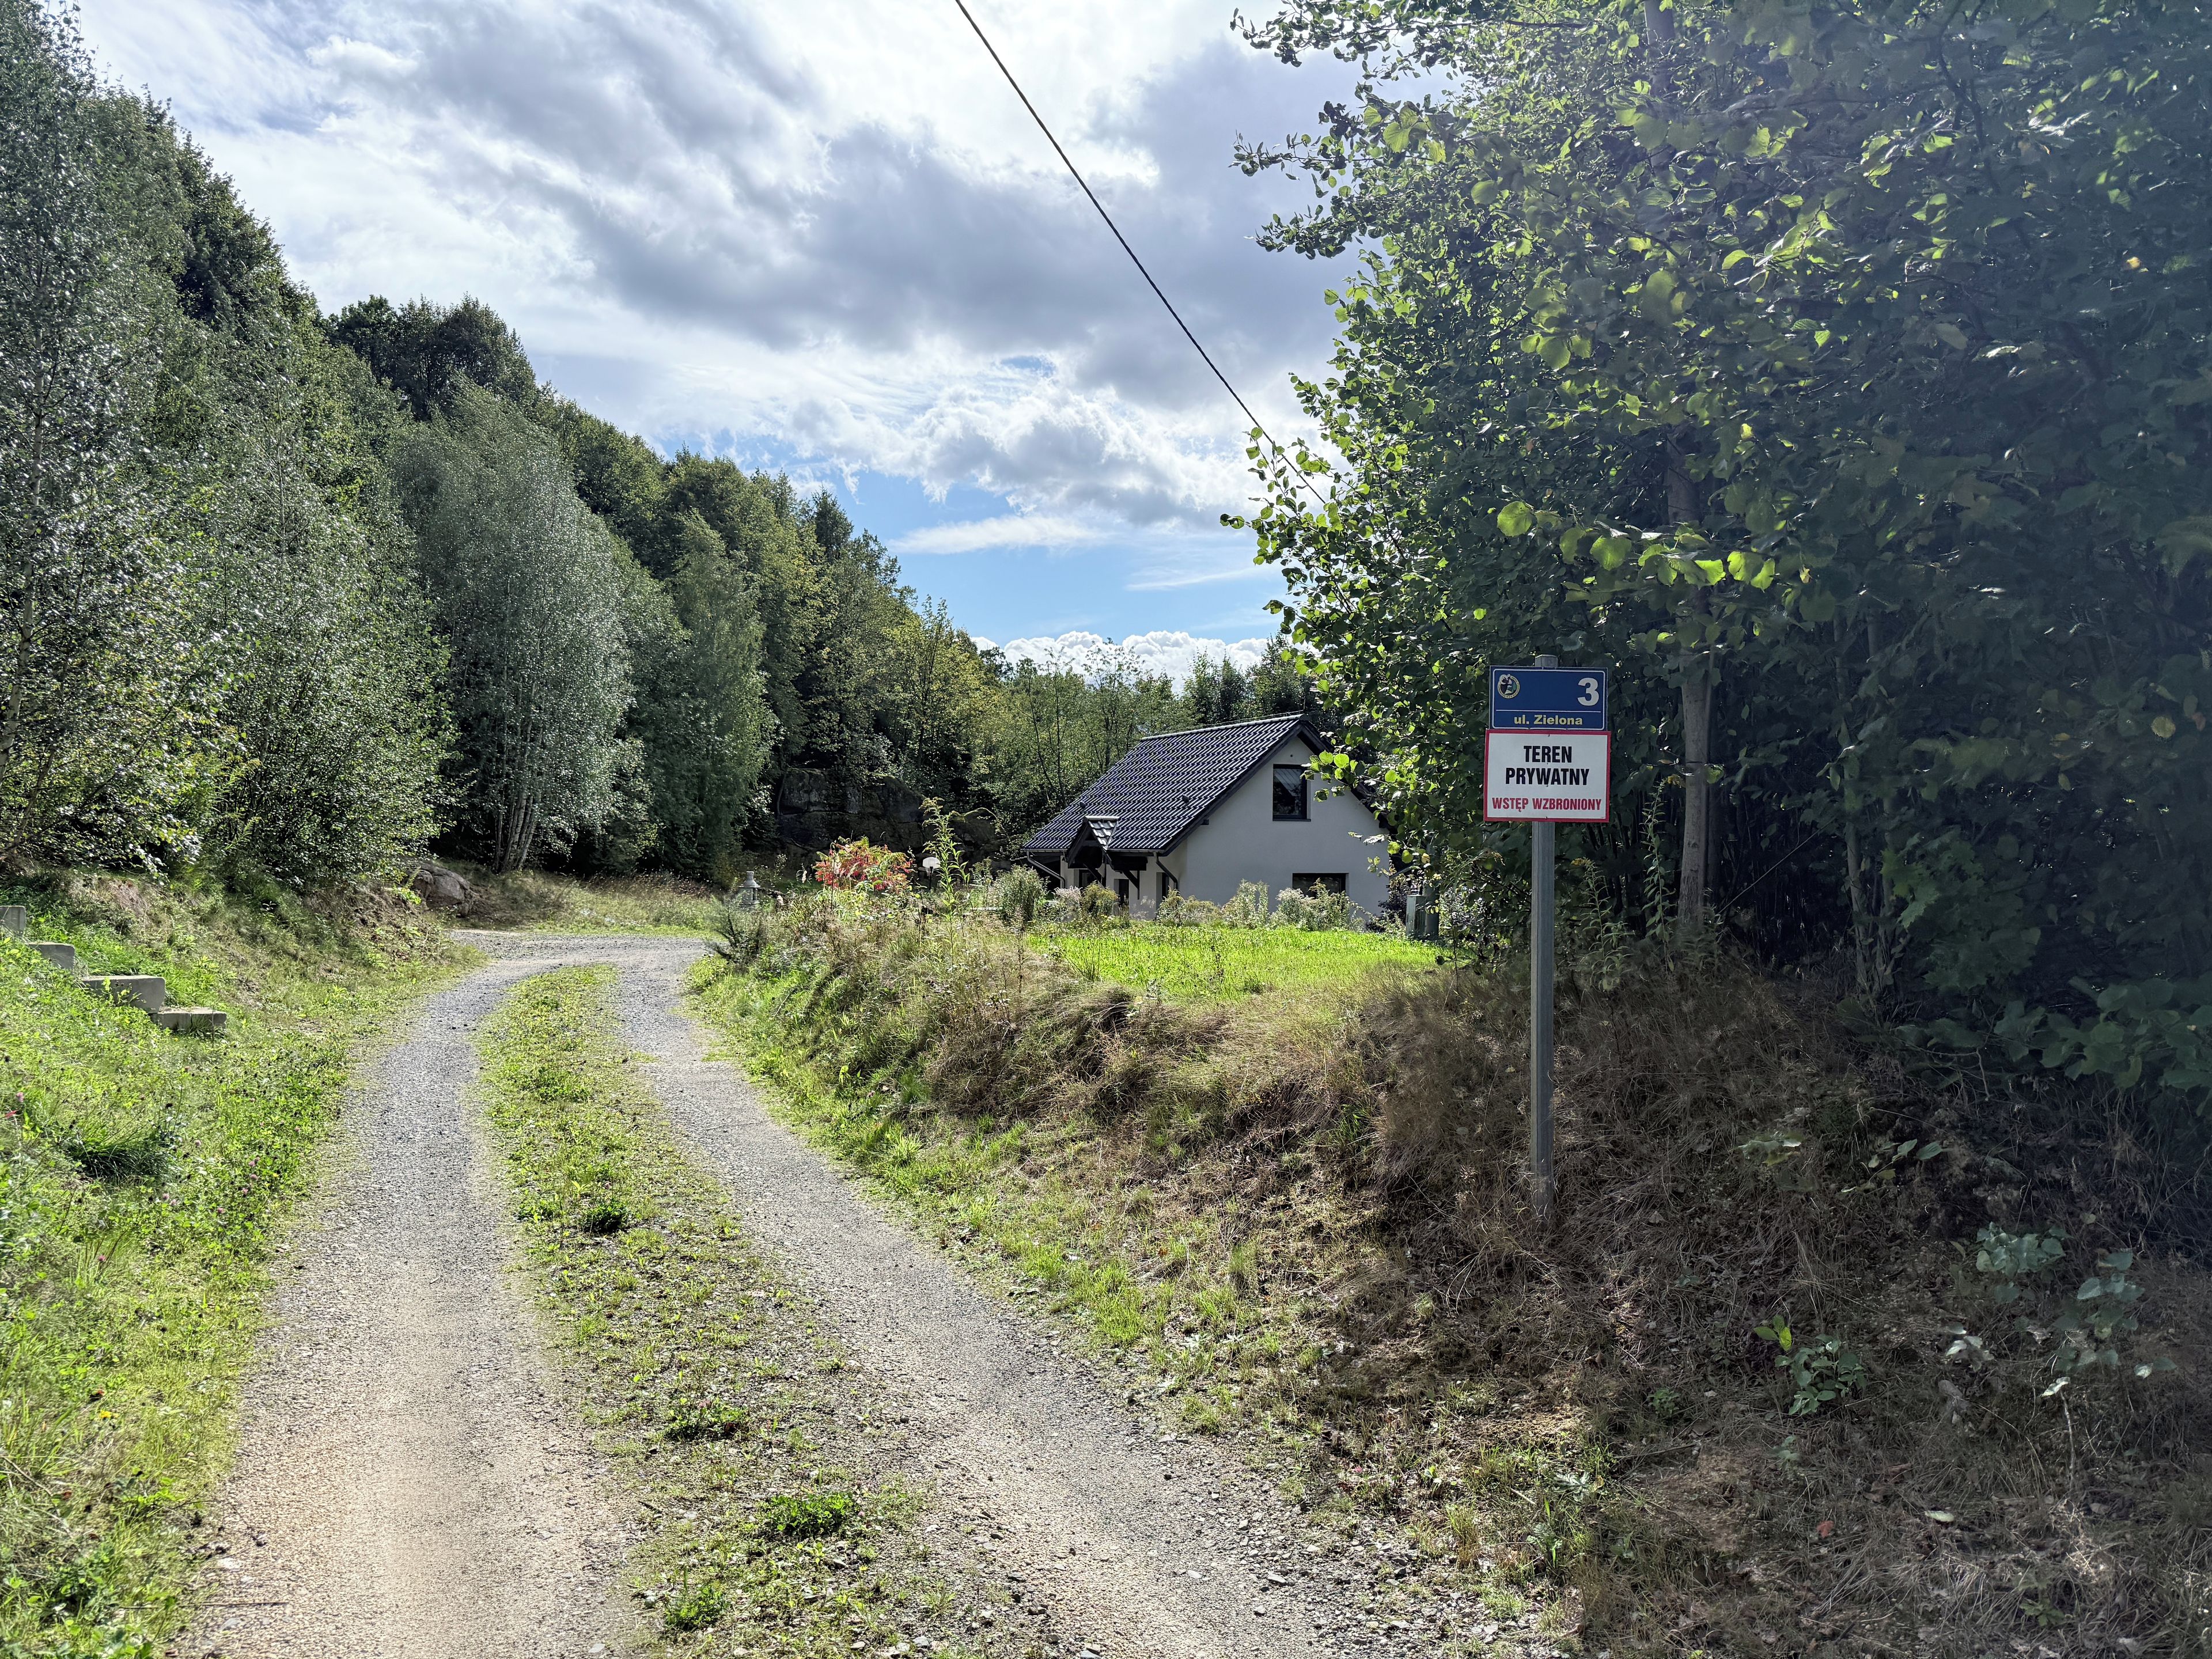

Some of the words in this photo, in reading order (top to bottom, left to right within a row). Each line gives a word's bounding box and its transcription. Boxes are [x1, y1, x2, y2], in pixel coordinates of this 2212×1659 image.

[1577, 677, 1600, 706] 3
[1514, 715, 1529, 725] ul.
[1533, 715, 1582, 725] Zielona
[1523, 745, 1572, 763] TEREN
[1505, 767, 1590, 786] PRYWATNY
[1492, 797, 1529, 812] WSTĘP
[1532, 798, 1601, 810] WZBRONIONY
